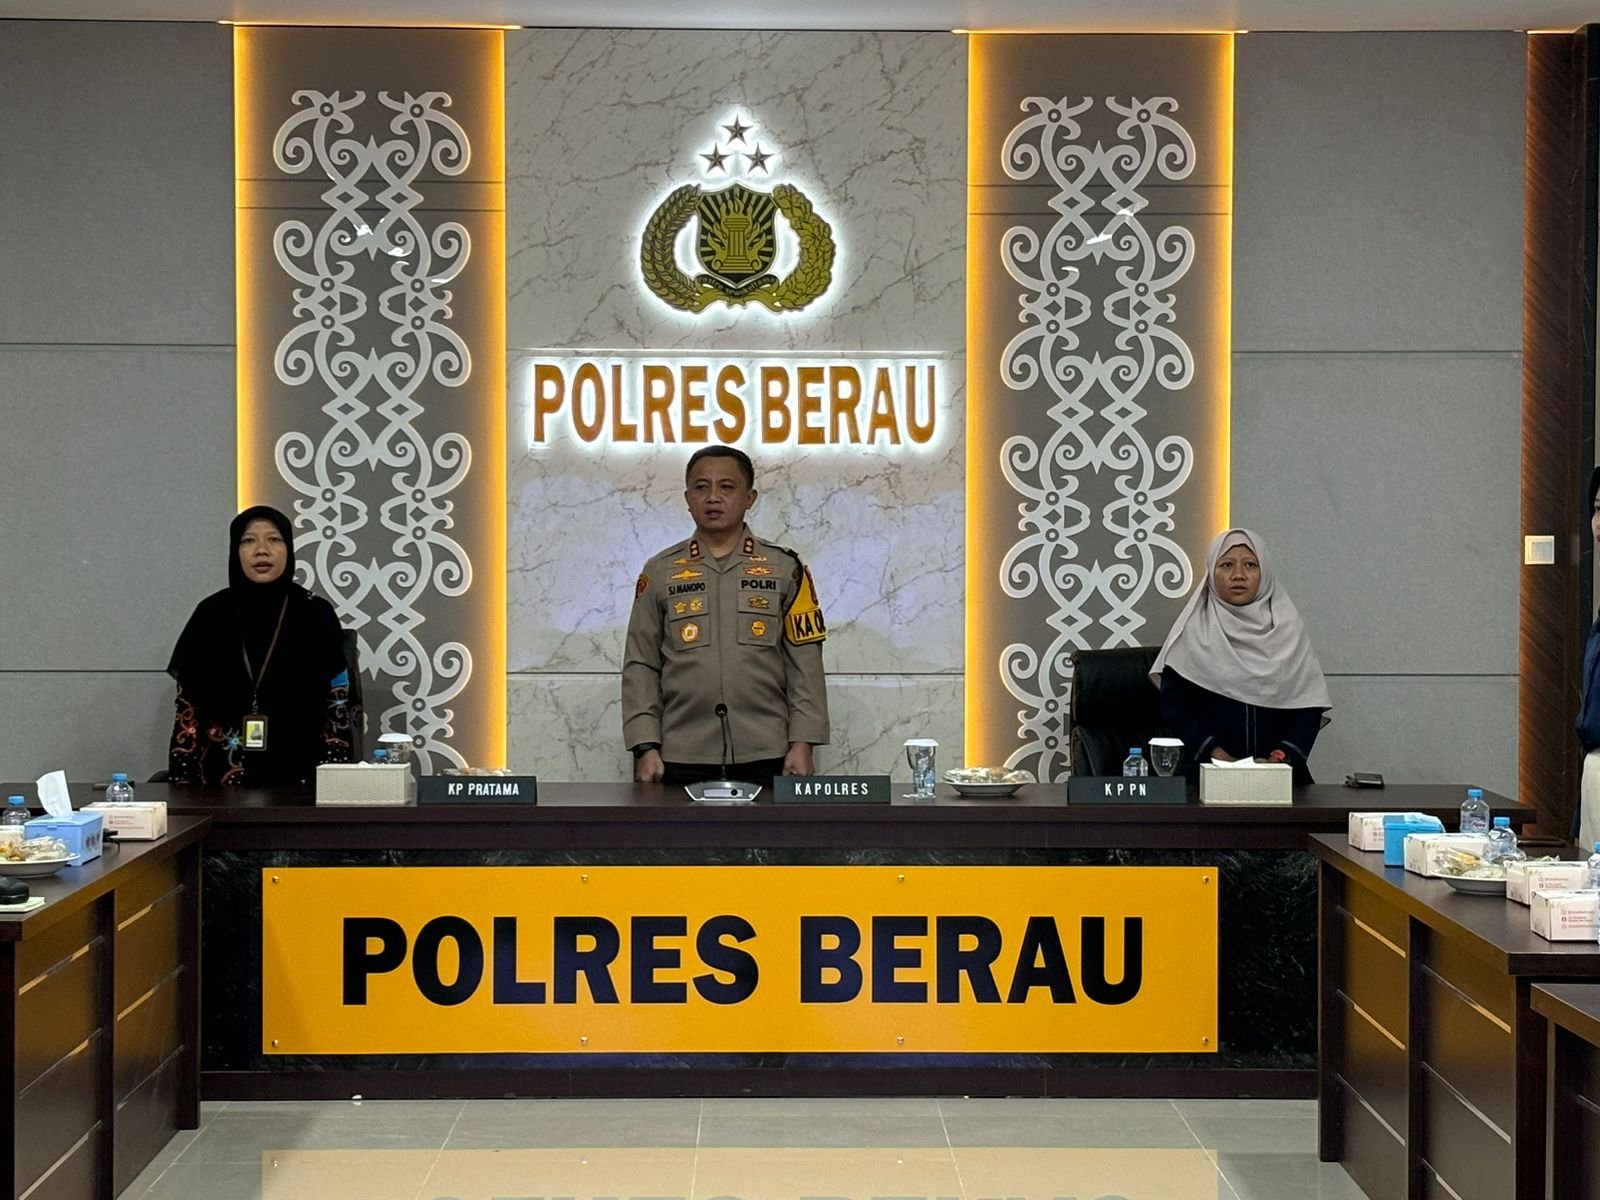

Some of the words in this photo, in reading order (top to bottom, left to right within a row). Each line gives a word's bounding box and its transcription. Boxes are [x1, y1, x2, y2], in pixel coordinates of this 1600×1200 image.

[533, 362, 746, 443] POLRES
[760, 366, 936, 445] BERAU
[676, 582, 706, 594] MANOPO
[741, 579, 777, 590] POLRI
[794, 611, 814, 639] KA
[448, 783, 463, 796] KP
[468, 783, 519, 796] PRATAMA
[795, 782, 869, 796] KAPOLRES
[1105, 783, 1147, 796] KPPN
[342, 915, 759, 1005] POLRES
[800, 915, 1143, 1005] BERAU
